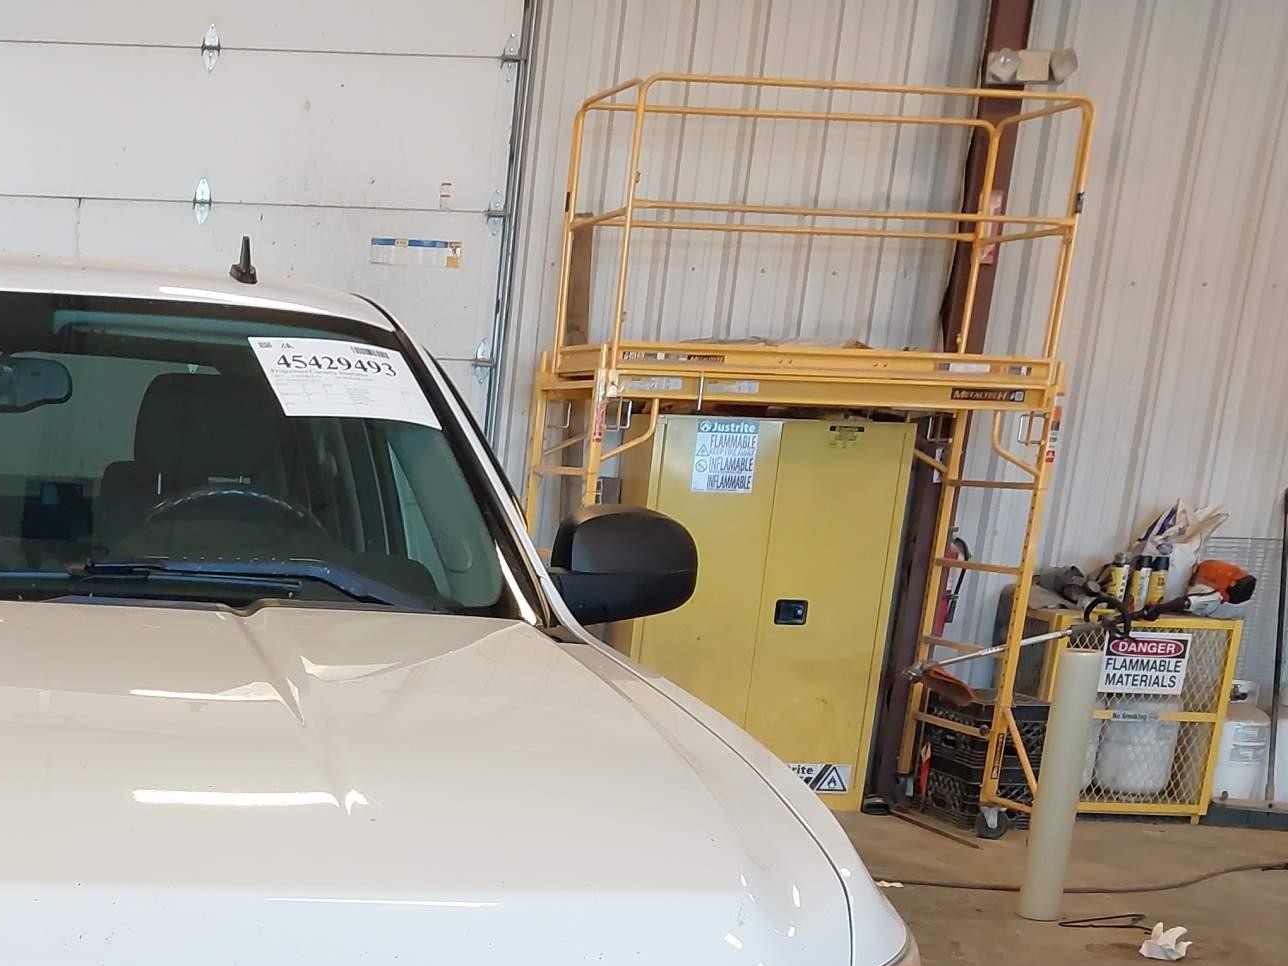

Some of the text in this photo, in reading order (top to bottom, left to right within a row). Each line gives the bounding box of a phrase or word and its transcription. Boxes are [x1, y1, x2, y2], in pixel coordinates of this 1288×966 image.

[277, 354, 396, 376] 45429493
[712, 421, 756, 433] Justrite
[710, 434, 757, 449] FLAMMABLE
[708, 456, 754, 472] INFLAMABLE
[706, 474, 752, 490] INFLAMMABLE
[1118, 641, 1176, 654] DANGER
[1105, 657, 1182, 673] FLAMMABLE
[1104, 672, 1177, 688] MATERIALS
[791, 764, 814, 775] rite
